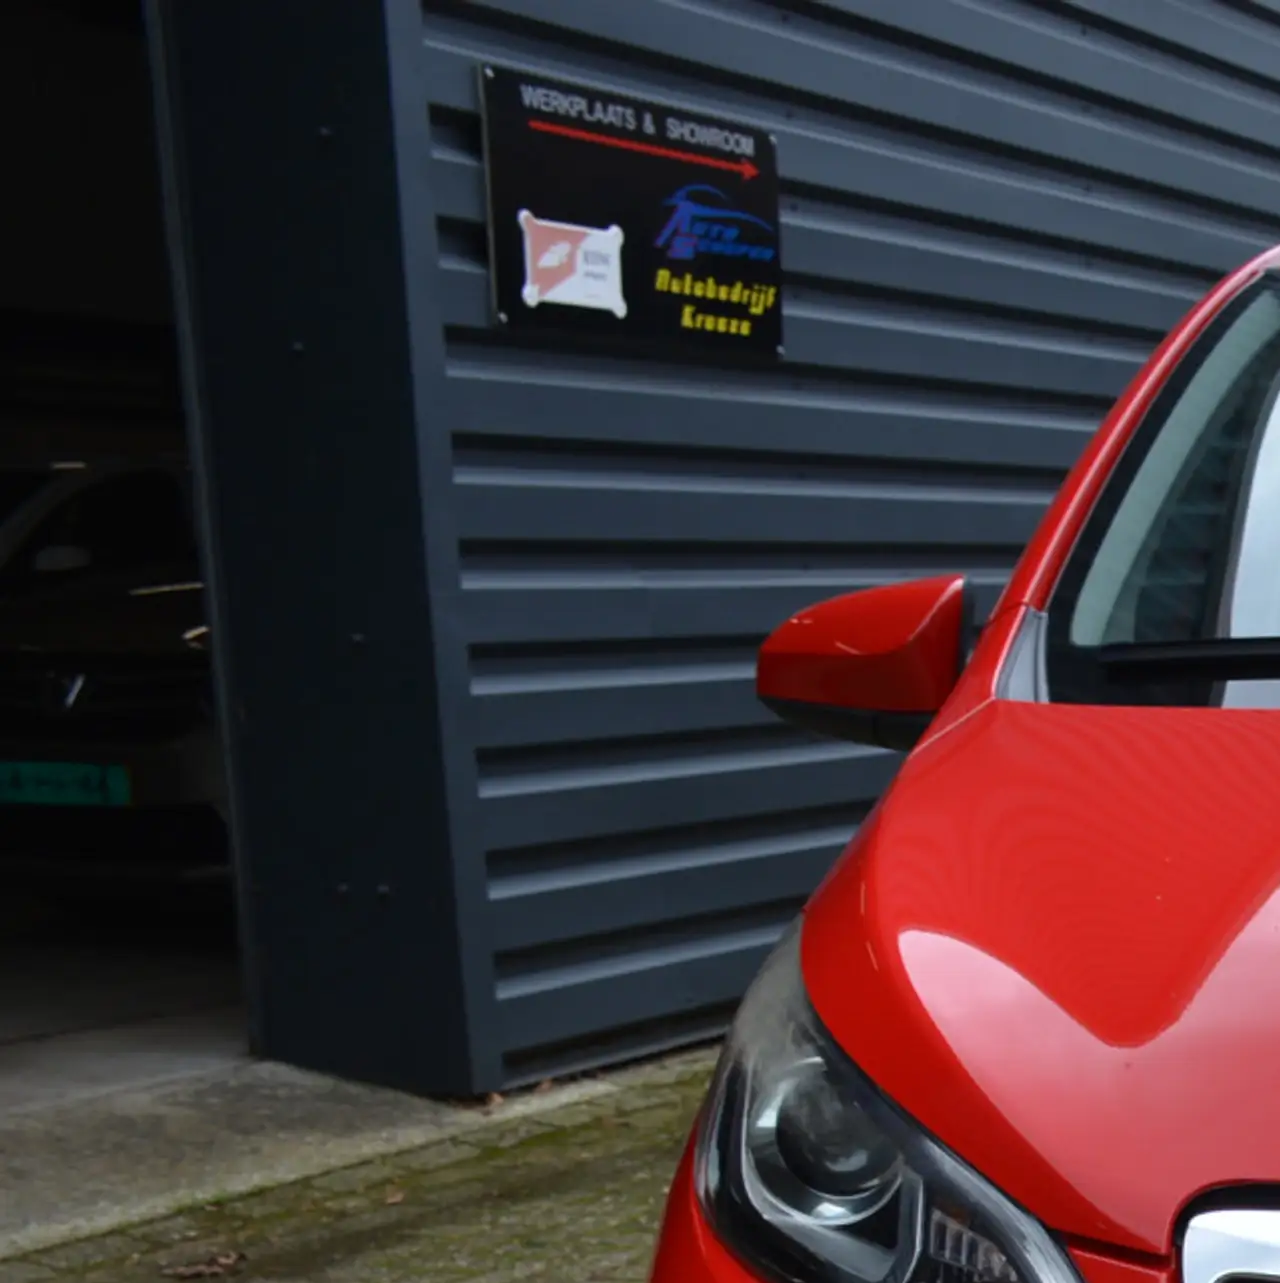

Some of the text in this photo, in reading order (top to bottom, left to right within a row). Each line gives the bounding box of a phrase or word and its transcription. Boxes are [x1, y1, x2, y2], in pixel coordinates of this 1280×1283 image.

[520, 84, 755, 157] WERKPLAATS & SHOWROOM
[654, 267, 777, 316] Autobedrijf
